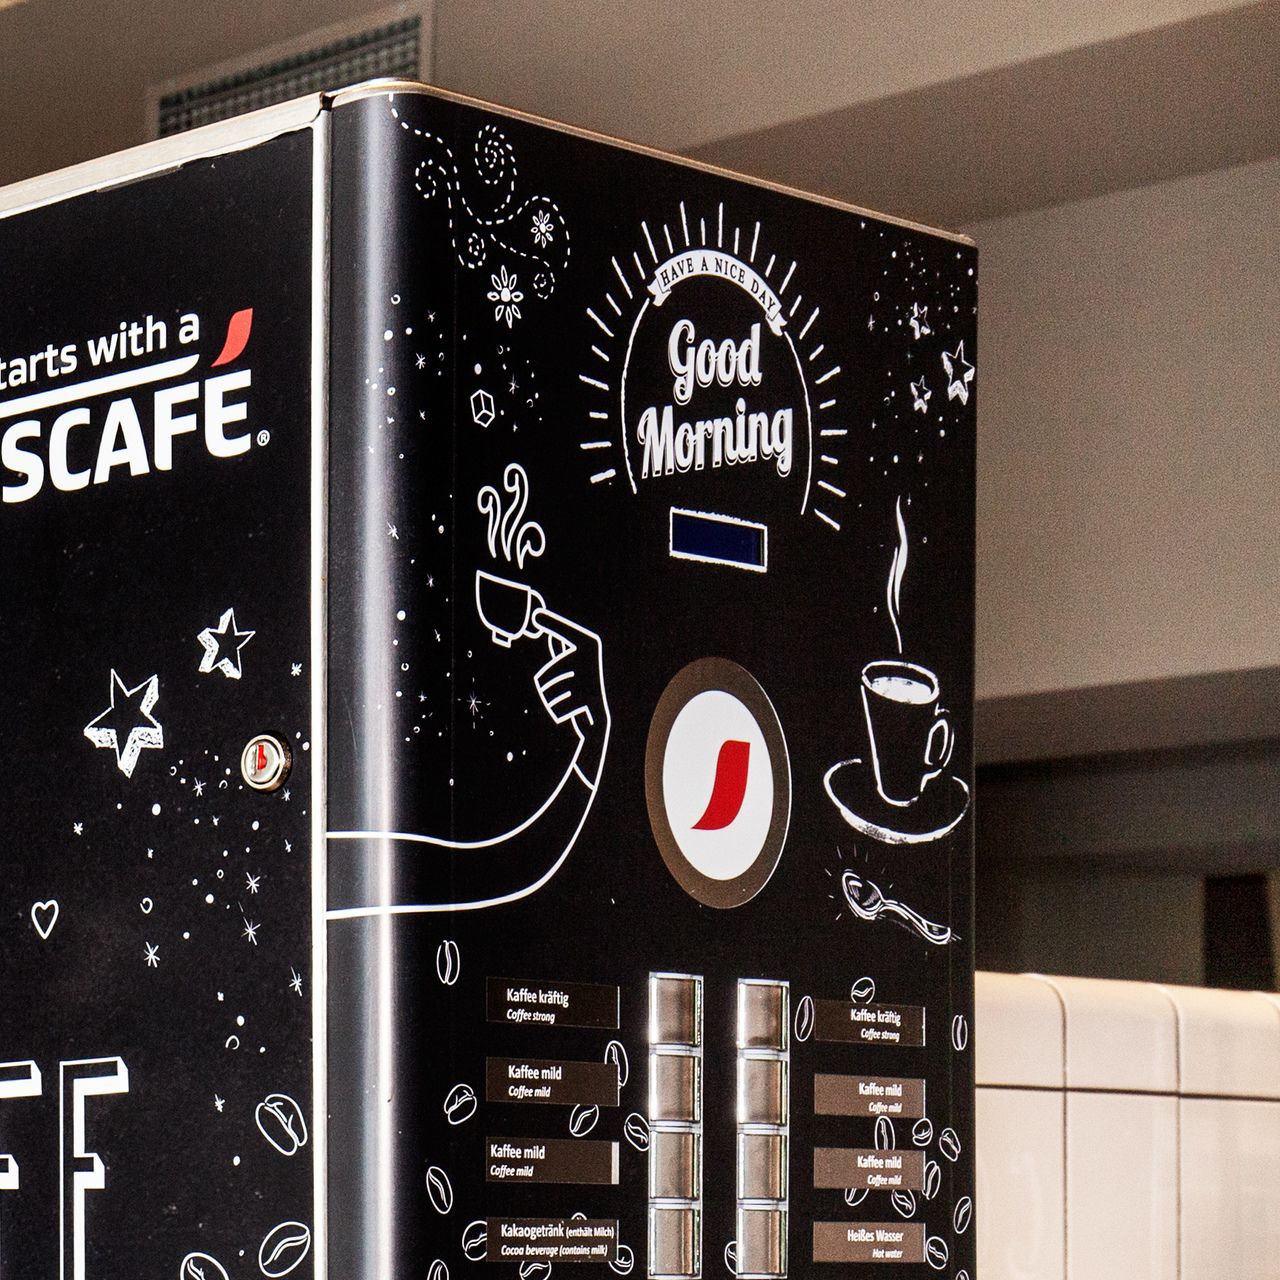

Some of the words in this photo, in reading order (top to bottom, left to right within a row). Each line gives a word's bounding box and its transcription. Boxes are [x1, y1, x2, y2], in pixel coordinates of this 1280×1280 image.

[660, 258, 695, 286] HAVE
[700, 258, 709, 271] A
[714, 259, 746, 284] NICE
[750, 281, 777, 311] DAY
[87, 316, 166, 367] with
[179, 312, 199, 344] a
[668, 319, 762, 405] Good
[637, 398, 792, 478] Morning
[507, 988, 537, 1003] Kaffee
[539, 990, 569, 1008] kräftig
[507, 1009, 532, 1022] Coffee
[533, 1012, 555, 1024] strong
[851, 1009, 876, 1022] Kaffee
[877, 1010, 900, 1026] kräftig
[861, 1028, 880, 1040] Coffee
[882, 1030, 900, 1042] strong
[508, 1065, 539, 1079] Kaffee
[541, 1066, 562, 1080] mild
[508, 1085, 533, 1098] Coffee
[535, 1086, 551, 1097] mild
[859, 1083, 884, 1096] Kaffee
[886, 1084, 902, 1096] mild
[869, 1102, 887, 1114] Coffee
[490, 1144, 522, 1159] Kaffee
[524, 1145, 545, 1159] mild
[858, 1156, 883, 1168] Kaffee
[885, 1156, 901, 1169] mild
[490, 1165, 515, 1178] Coffee
[516, 1165, 533, 1177] mild
[867, 1174, 886, 1187] Coffee
[501, 1223, 564, 1238] Kakaogetränk
[848, 1230, 874, 1242] Heißes
[876, 1230, 903, 1242] Wasser
[501, 1244, 524, 1255] Cocoa
[525, 1244, 558, 1257] beverage
